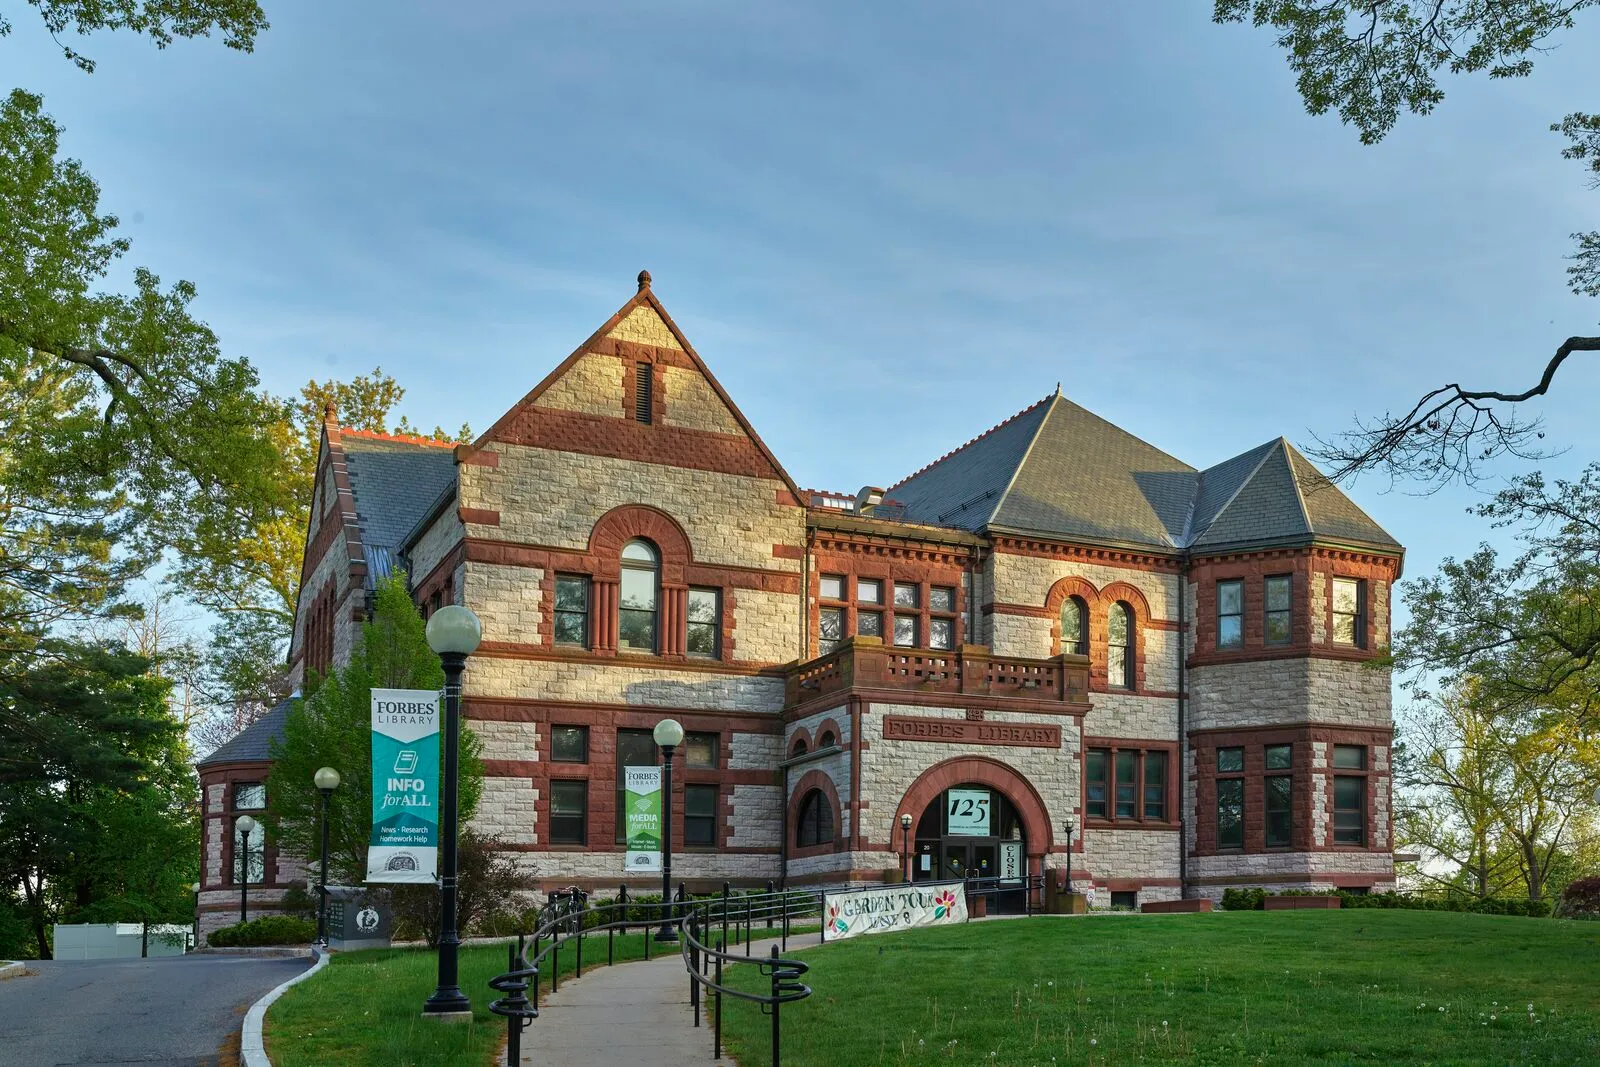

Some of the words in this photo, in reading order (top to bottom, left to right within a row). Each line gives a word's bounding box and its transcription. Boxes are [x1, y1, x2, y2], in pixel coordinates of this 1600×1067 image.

[377, 701, 435, 715] FORBES
[378, 715, 433, 725] LIBRARY
[888, 721, 965, 739] FORBES
[977, 726, 1058, 743] LIBRARY
[628, 772, 659, 780] FORBES
[387, 778, 425, 792] INFO
[949, 799, 989, 823] 125
[629, 814, 658, 822] MEDIA
[401, 826, 429, 834] Research
[379, 835, 413, 843] Homework
[413, 835, 428, 844] Help
[843, 894, 895, 917] GARDEN
[898, 892, 935, 910] TOUR
[903, 911, 911, 924] 8
